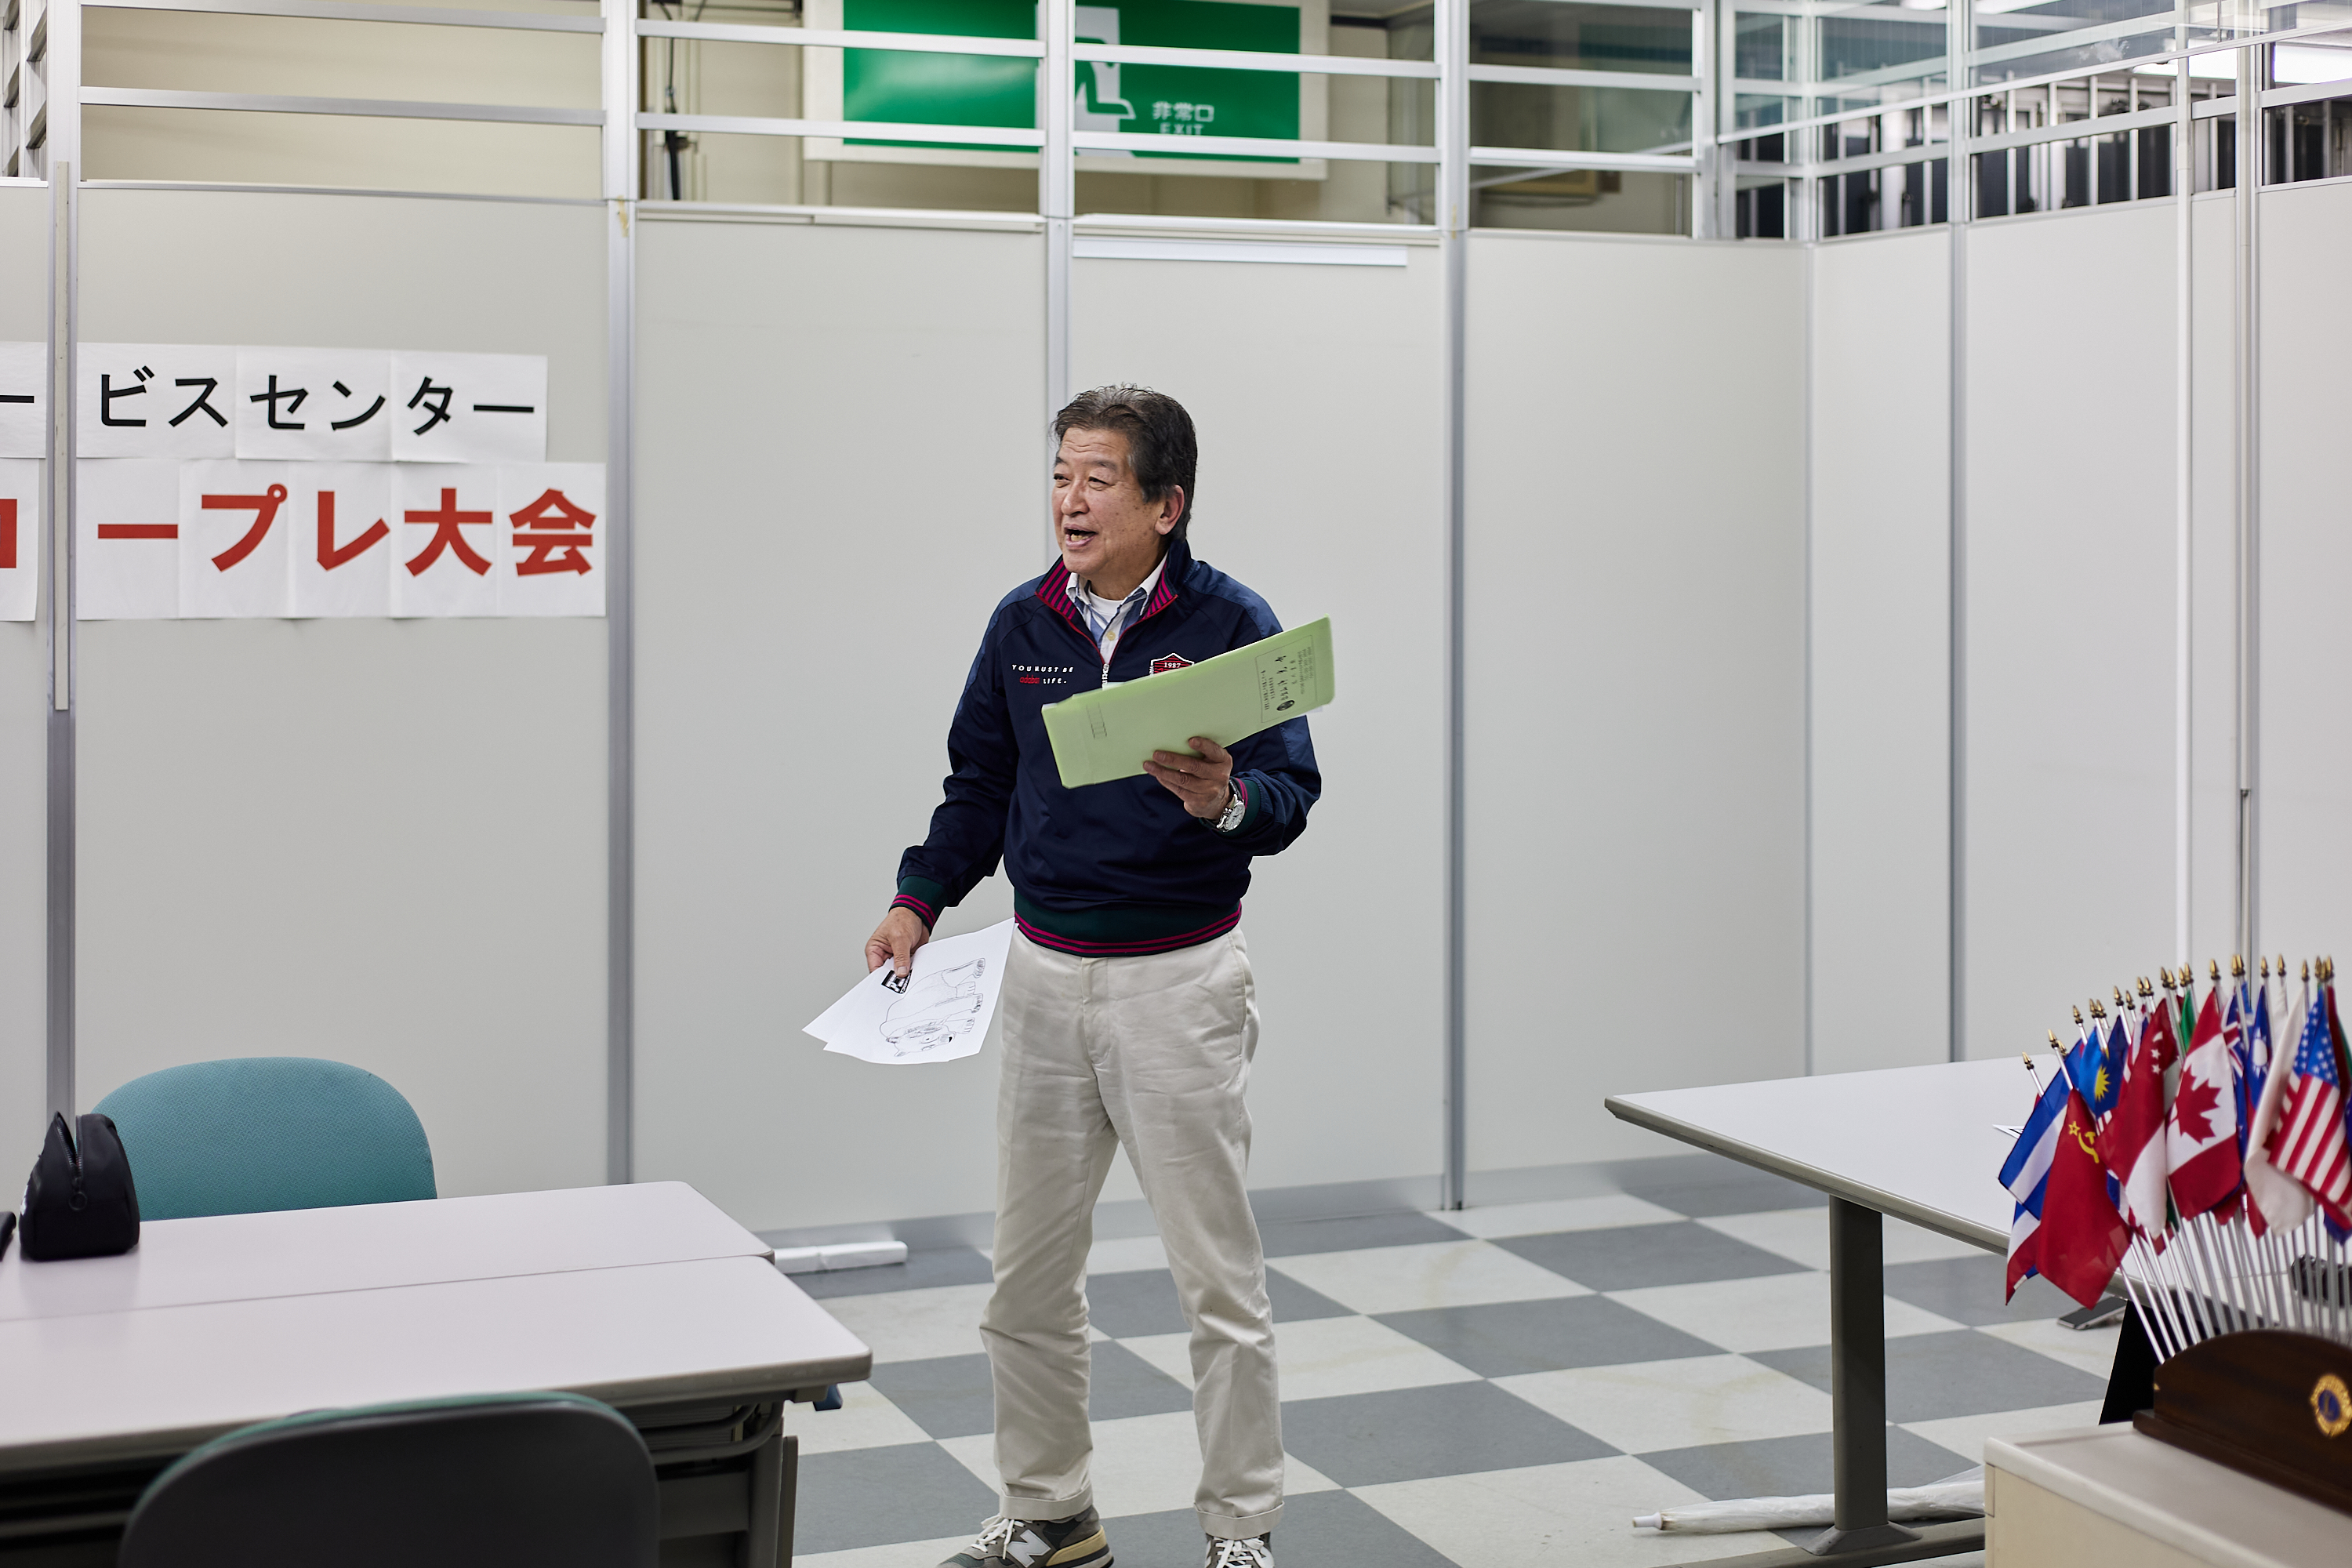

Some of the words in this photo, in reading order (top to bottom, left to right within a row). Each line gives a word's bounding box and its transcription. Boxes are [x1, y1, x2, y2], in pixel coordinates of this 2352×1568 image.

[1152, 101, 1214, 122] 非常口
[1160, 122, 1203, 135] EXIT
[0, 483, 597, 577] ープレ大会
